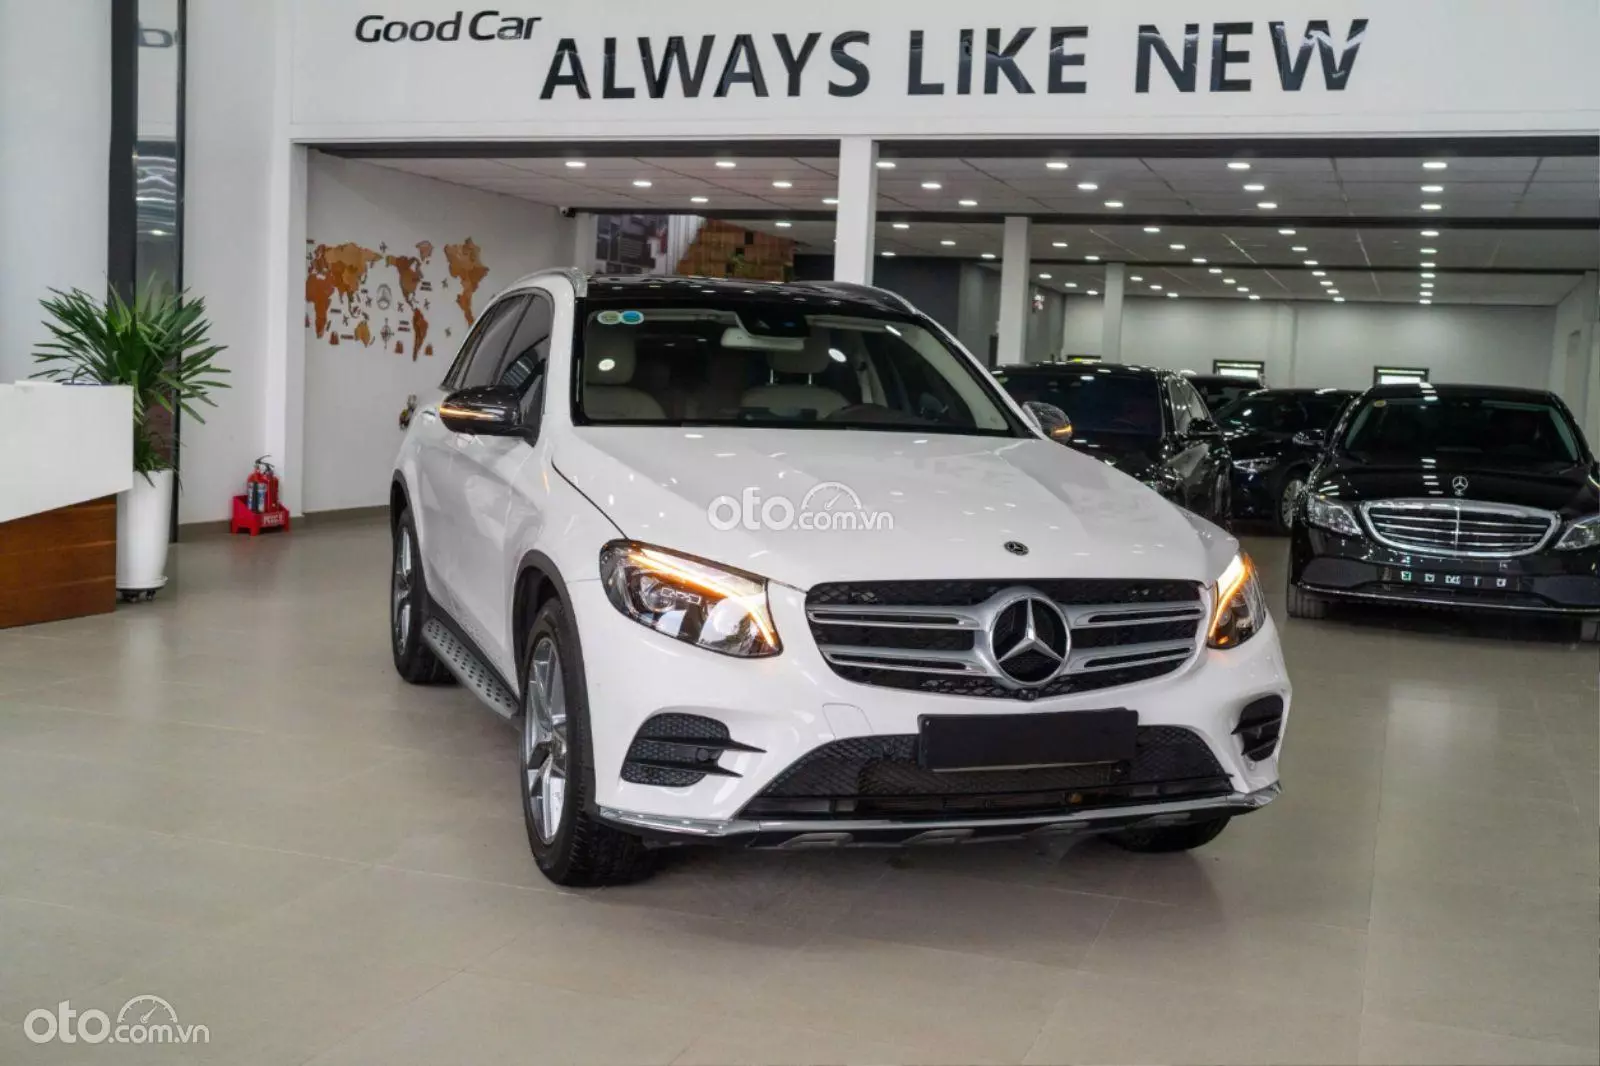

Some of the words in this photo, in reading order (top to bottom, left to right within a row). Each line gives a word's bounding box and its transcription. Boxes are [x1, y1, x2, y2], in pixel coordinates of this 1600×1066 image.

[355, 12, 463, 43] Good
[468, 10, 542, 41] Car
[540, 30, 870, 100] ALWAYS
[908, 26, 1089, 95] LIKE
[1135, 19, 1369, 93] NEW
